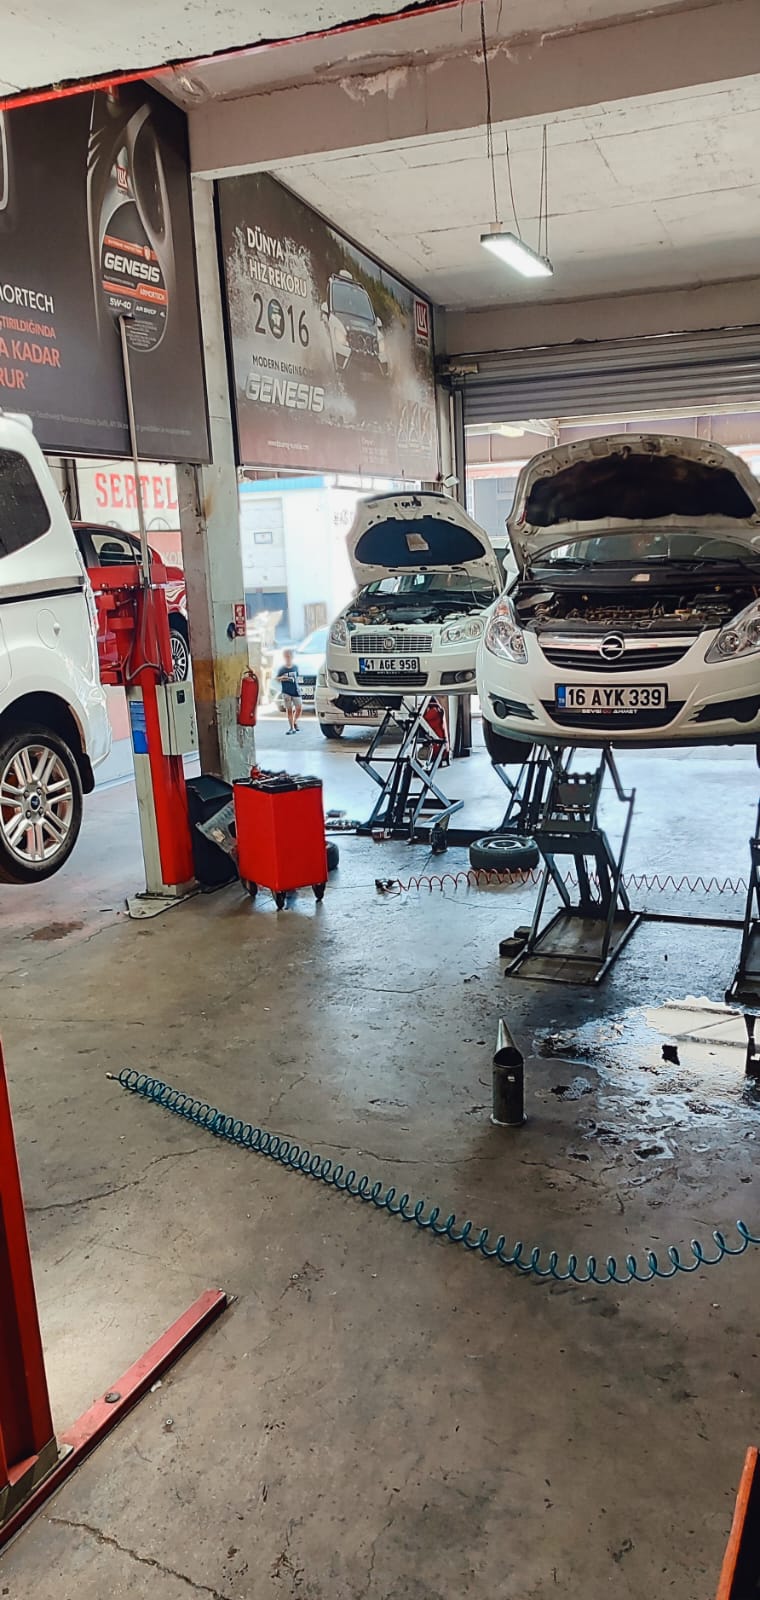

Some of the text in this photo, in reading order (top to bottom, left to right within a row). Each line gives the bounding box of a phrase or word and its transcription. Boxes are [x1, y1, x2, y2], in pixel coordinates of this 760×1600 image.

[246, 226, 284, 260] DÜNYA
[104, 252, 160, 283] GENESIS
[249, 259, 308, 298] HIZ REKORU
[109, 297, 132, 310] 5W-40
[253, 292, 309, 347] 2016
[11, 339, 61, 368] KADAR
[252, 354, 280, 373] MODERN
[280, 361, 303, 377] ENGINE
[245, 372, 325, 413] GENESIS
[365, 659, 417, 670] 41 AGE 958
[568, 688, 662, 706] 16 AYK 339
